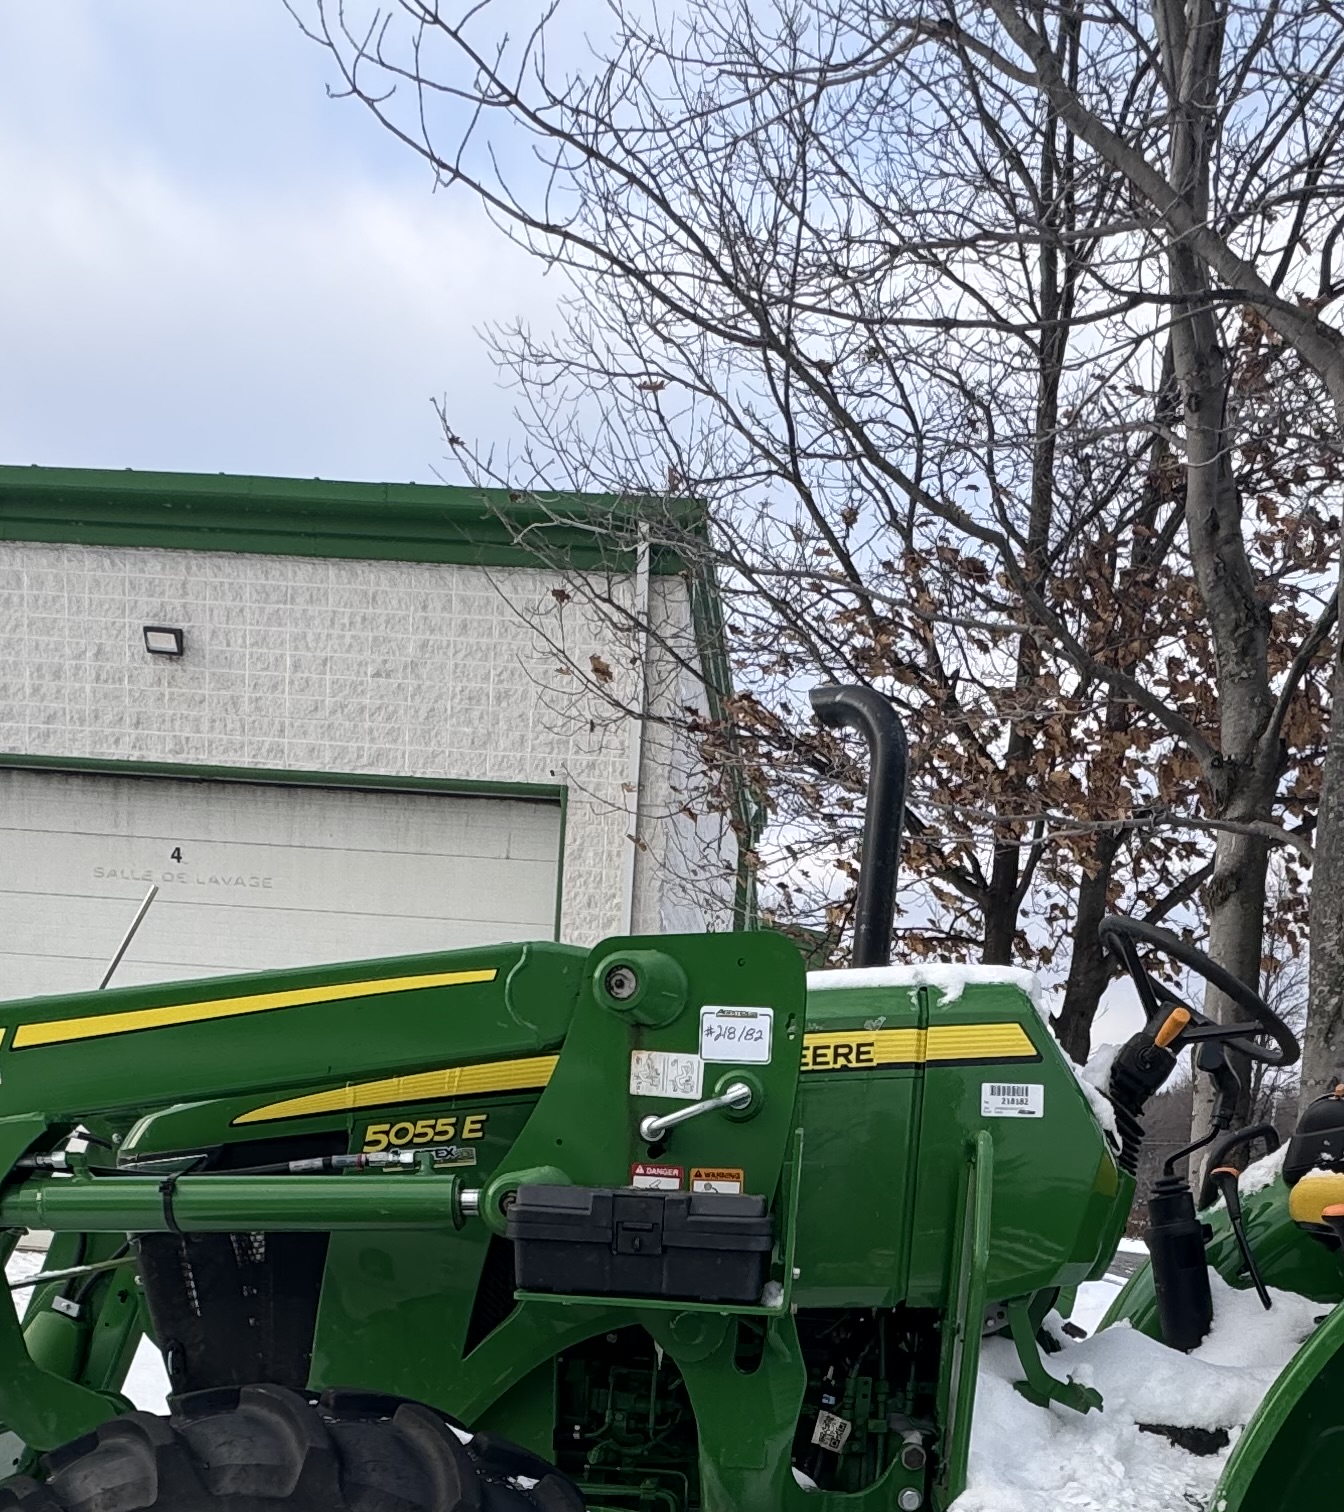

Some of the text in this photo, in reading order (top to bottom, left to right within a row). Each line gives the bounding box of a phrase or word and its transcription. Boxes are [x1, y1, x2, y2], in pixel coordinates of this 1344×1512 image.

[170, 846, 182, 863] 4
[93, 866, 154, 882] SALLE
[362, 1117, 456, 1153] 5055
[461, 1114, 488, 1139] E
[646, 1167, 679, 1177] DANGER
